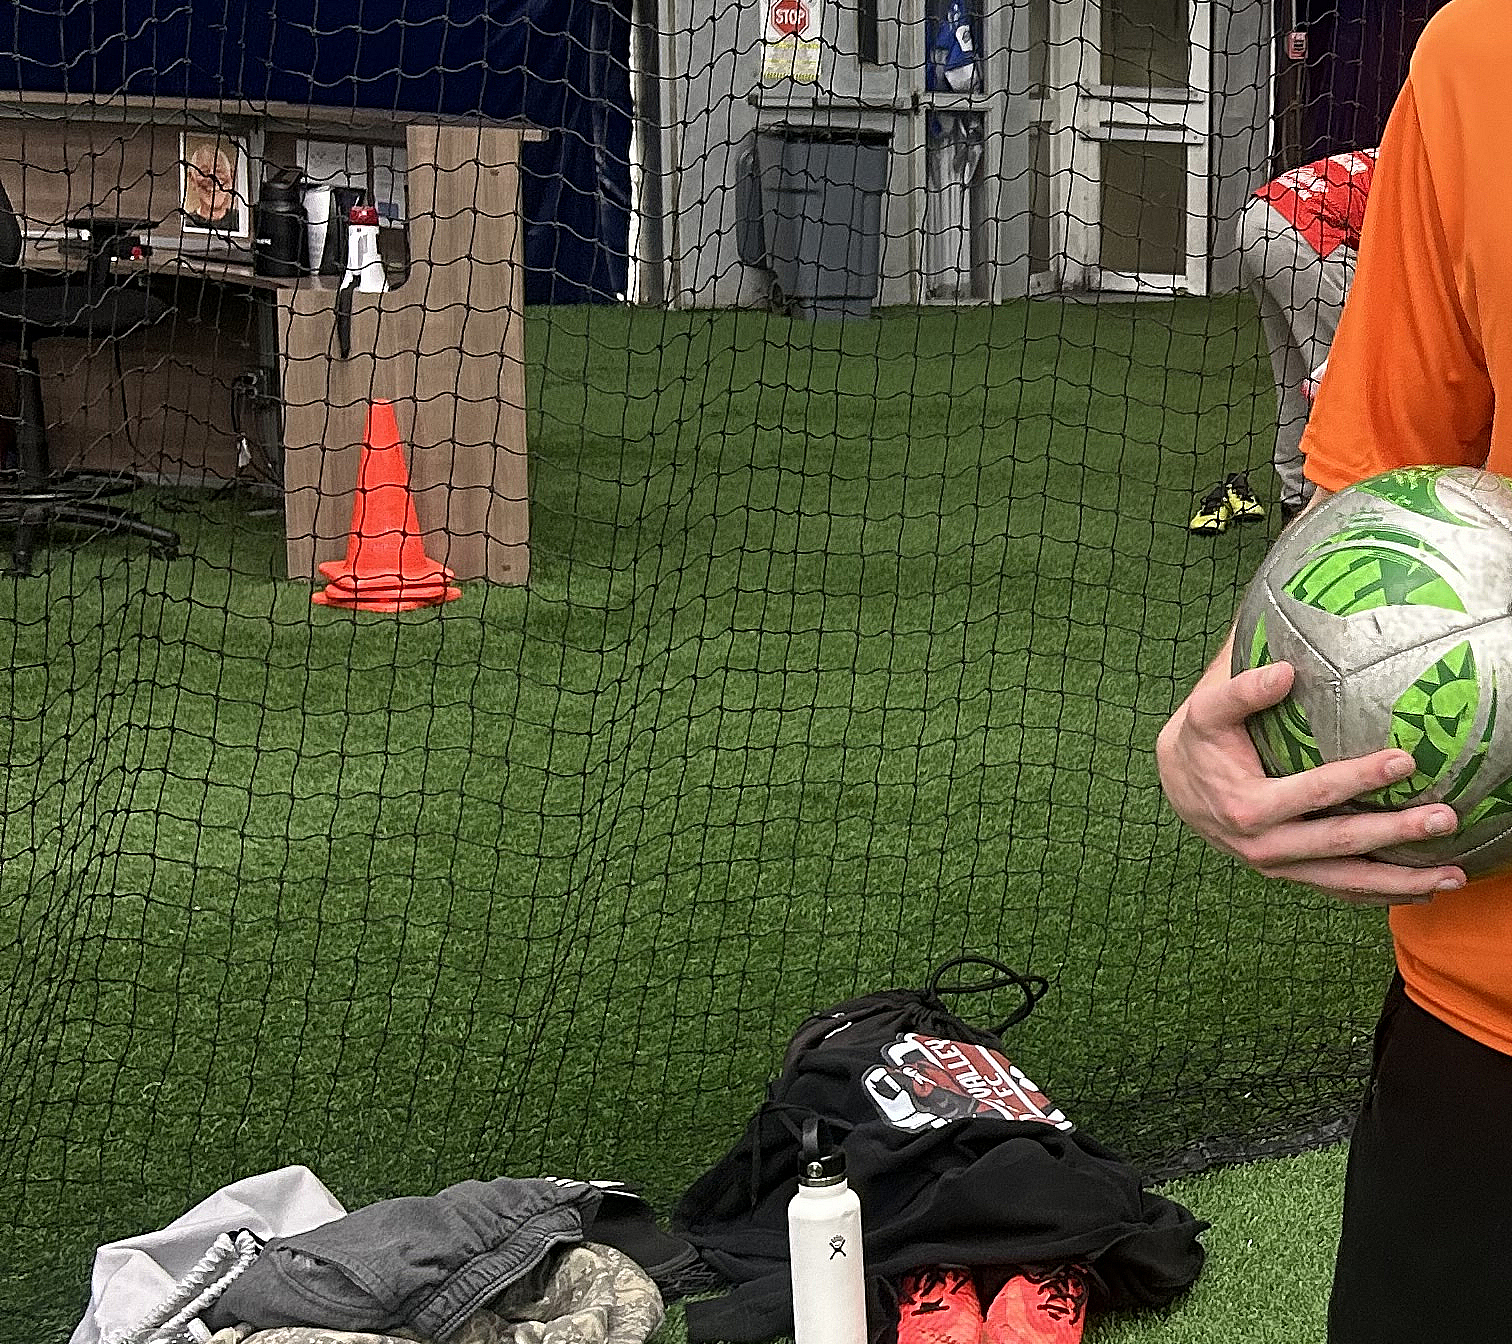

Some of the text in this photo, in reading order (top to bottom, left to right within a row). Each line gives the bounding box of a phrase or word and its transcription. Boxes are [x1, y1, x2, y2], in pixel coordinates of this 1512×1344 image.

[775, 8, 805, 25] STOP
[924, 1038, 992, 1099] VALLEY
[983, 1072, 1014, 1098] FC
